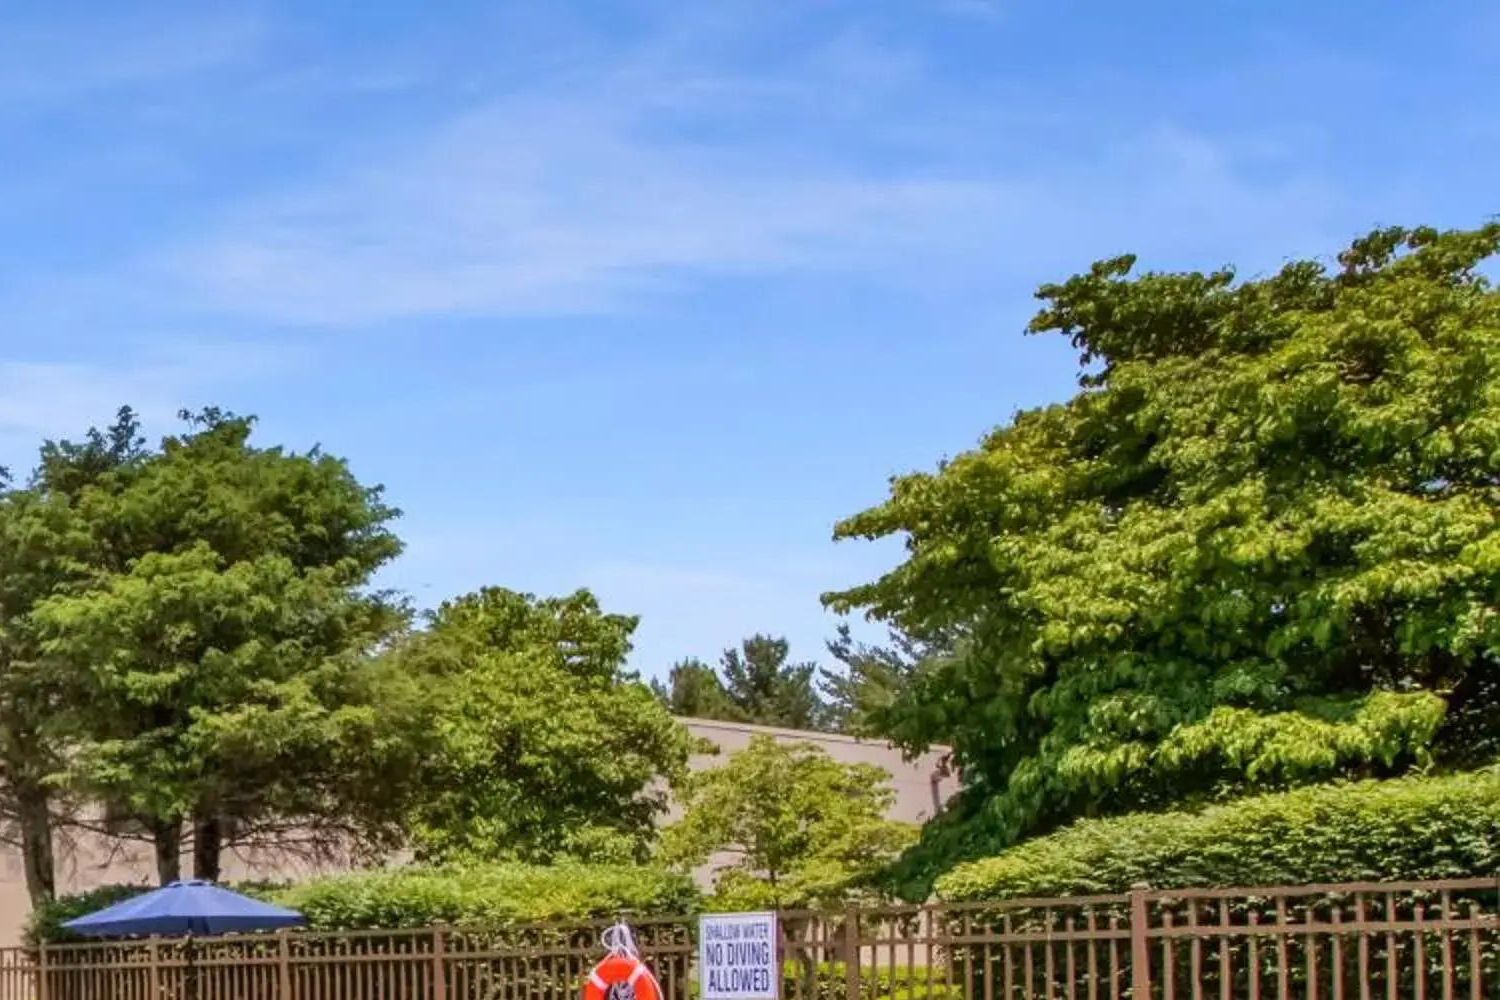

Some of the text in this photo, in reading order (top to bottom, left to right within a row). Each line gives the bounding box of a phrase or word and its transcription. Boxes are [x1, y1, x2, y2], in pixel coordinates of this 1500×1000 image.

[706, 922, 769, 940] SHALLOW WATER
[706, 941, 769, 966] NO DIVING
[708, 968, 770, 992] ALLOWED
